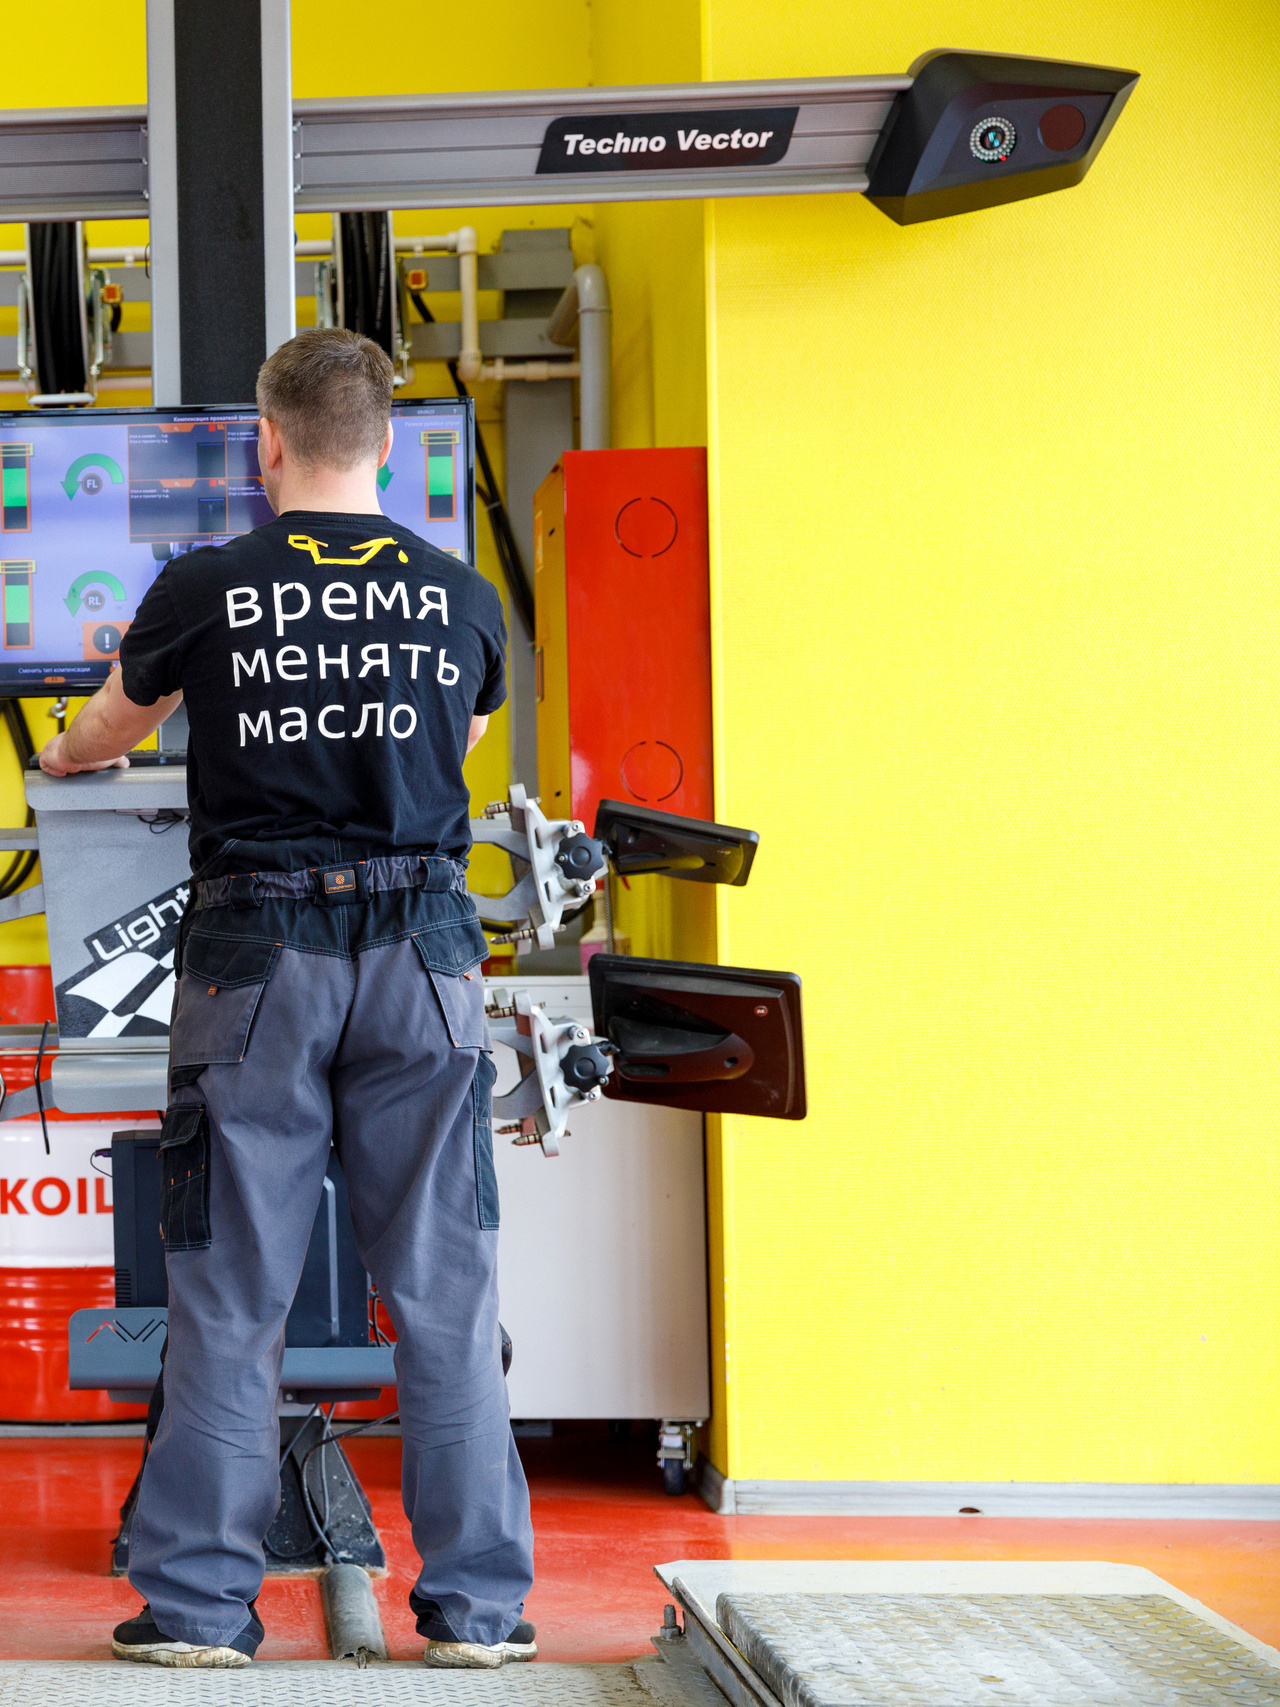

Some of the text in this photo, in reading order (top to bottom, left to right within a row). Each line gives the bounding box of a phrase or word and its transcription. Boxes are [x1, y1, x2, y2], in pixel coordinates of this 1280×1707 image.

[564, 128, 773, 155] Techno Vector
[86, 479, 99, 489] FL
[88, 596, 101, 606] RL
[226, 581, 449, 637] время
[18, 667, 42, 675] Сменить
[53, 666, 91, 674] компенсации
[232, 643, 460, 687] менять
[238, 702, 417, 747] масло
[91, 886, 190, 961] Light
